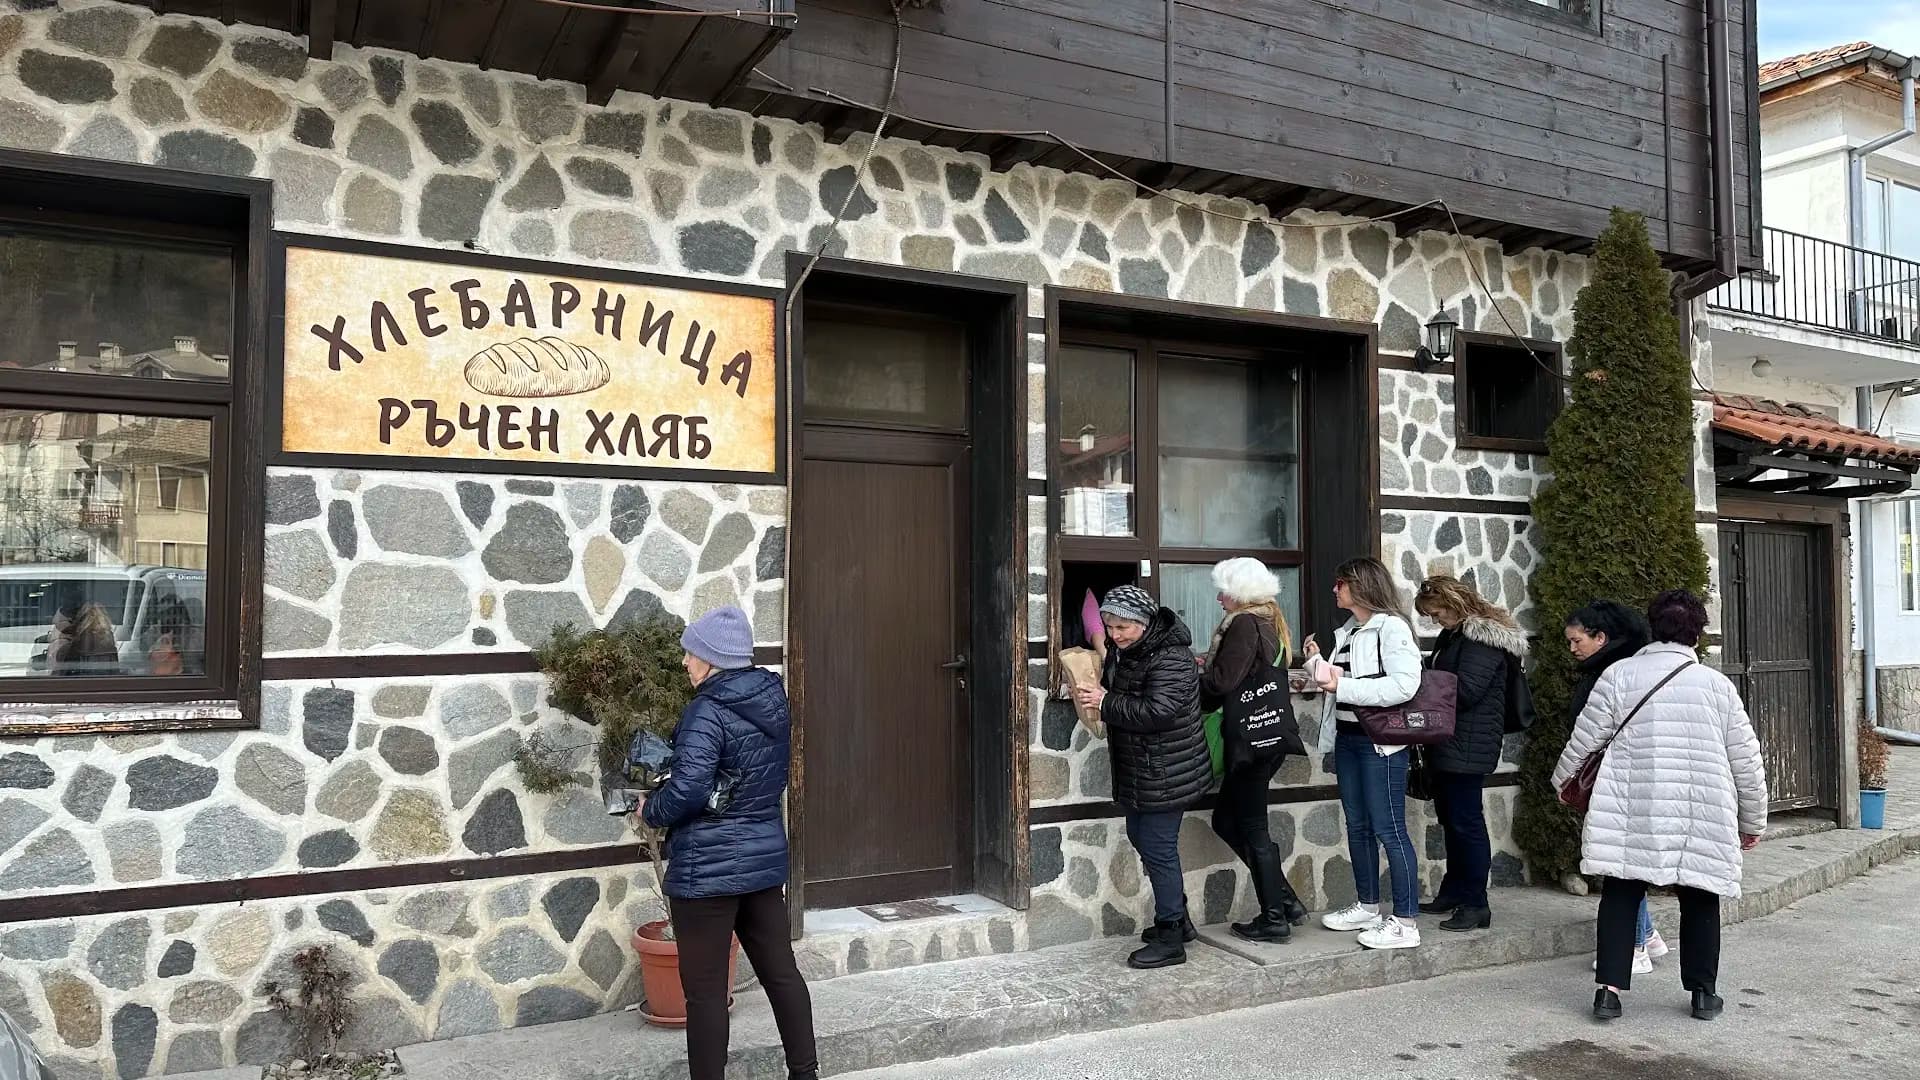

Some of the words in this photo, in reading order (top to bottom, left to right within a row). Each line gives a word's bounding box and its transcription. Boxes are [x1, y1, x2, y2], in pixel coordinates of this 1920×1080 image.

[311, 278, 752, 398] ХЛЕБАРНИЦА
[378, 397, 559, 454] РЪЧЕН
[585, 409, 711, 459] ХЛЯБ
[1256, 681, 1278, 696] eos
